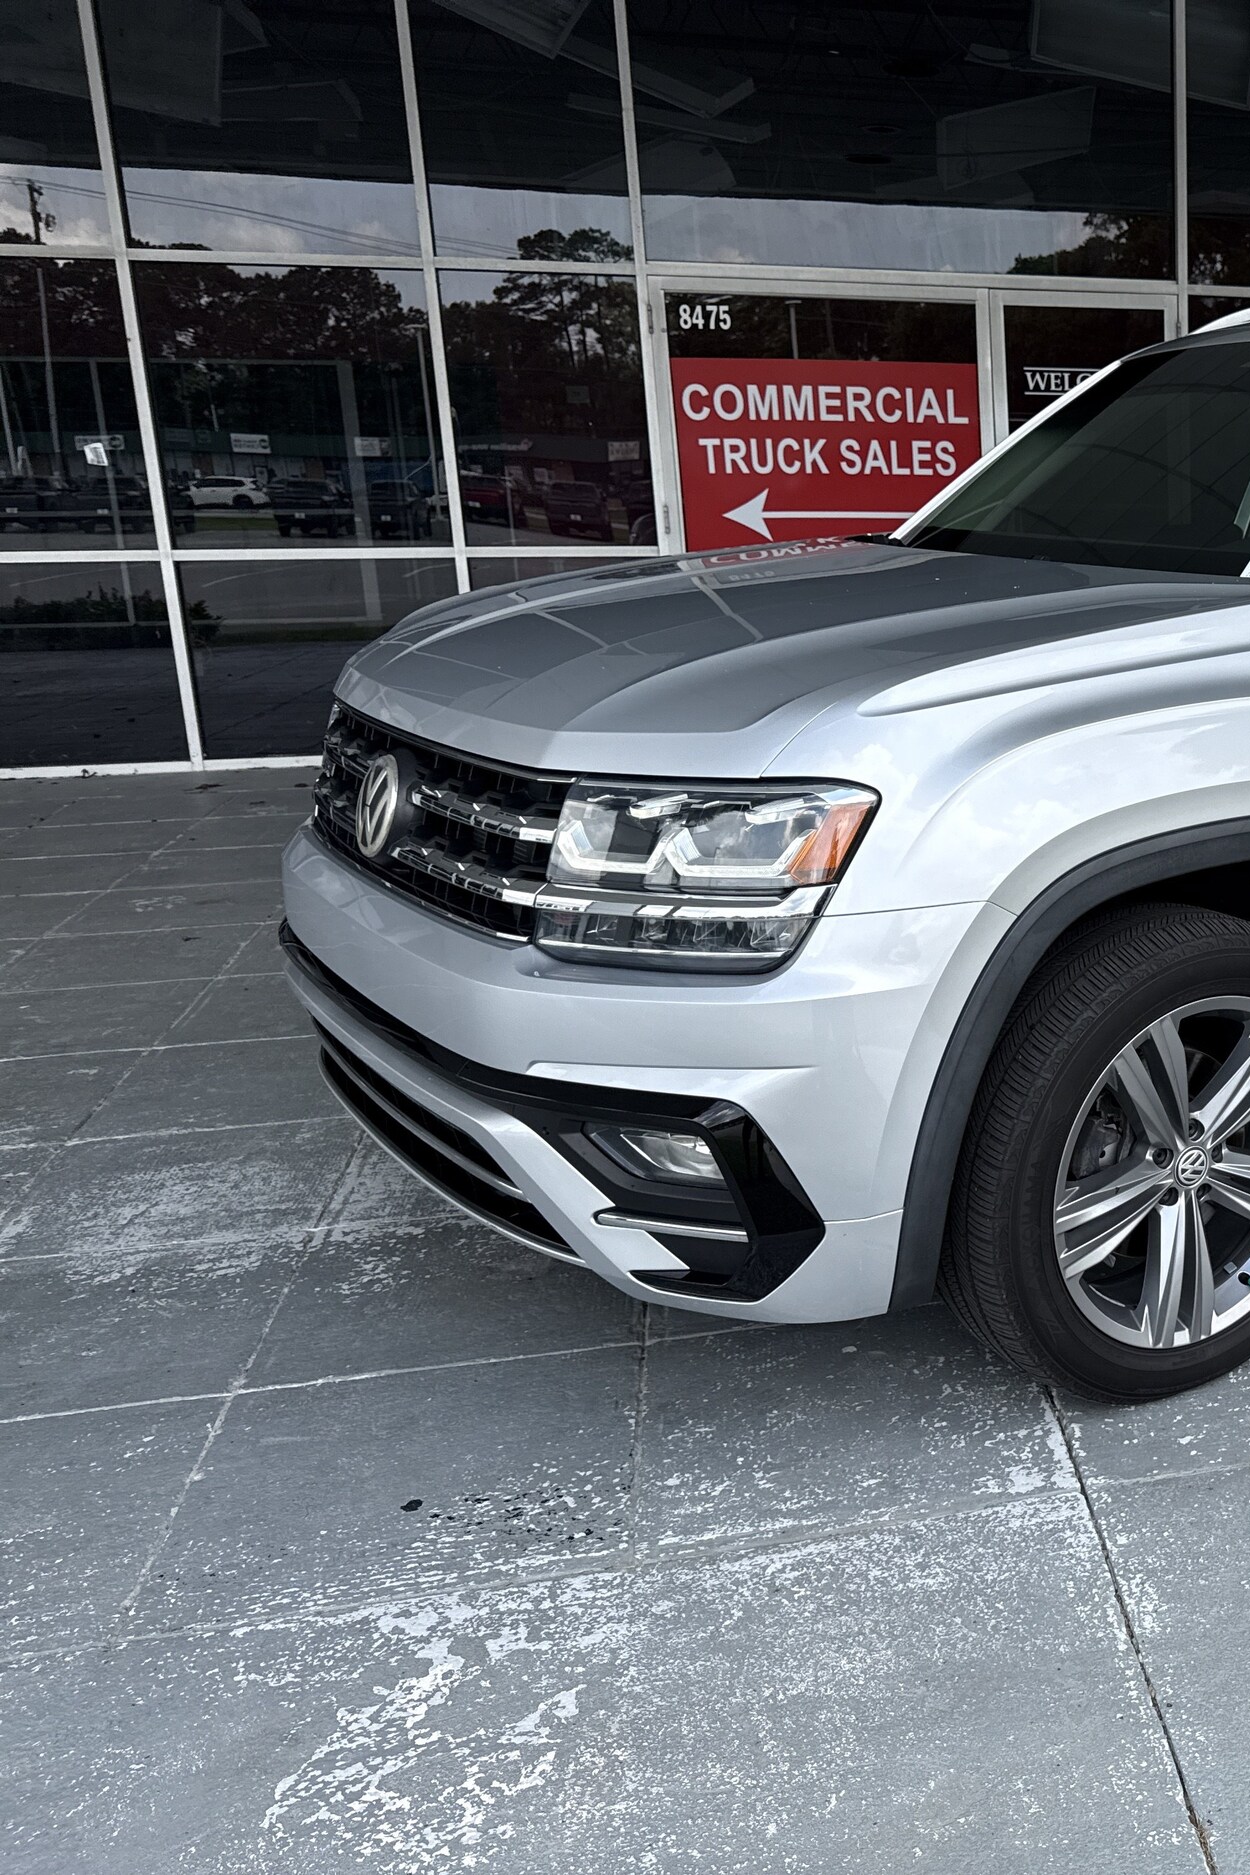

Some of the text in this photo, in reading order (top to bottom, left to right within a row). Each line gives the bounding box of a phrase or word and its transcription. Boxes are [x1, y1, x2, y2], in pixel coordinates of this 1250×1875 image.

[679, 304, 731, 330] 8475
[1024, 371, 1094, 391] WELC
[681, 383, 969, 425] COMMERCIAL
[698, 438, 957, 477] TRUCK SALES
